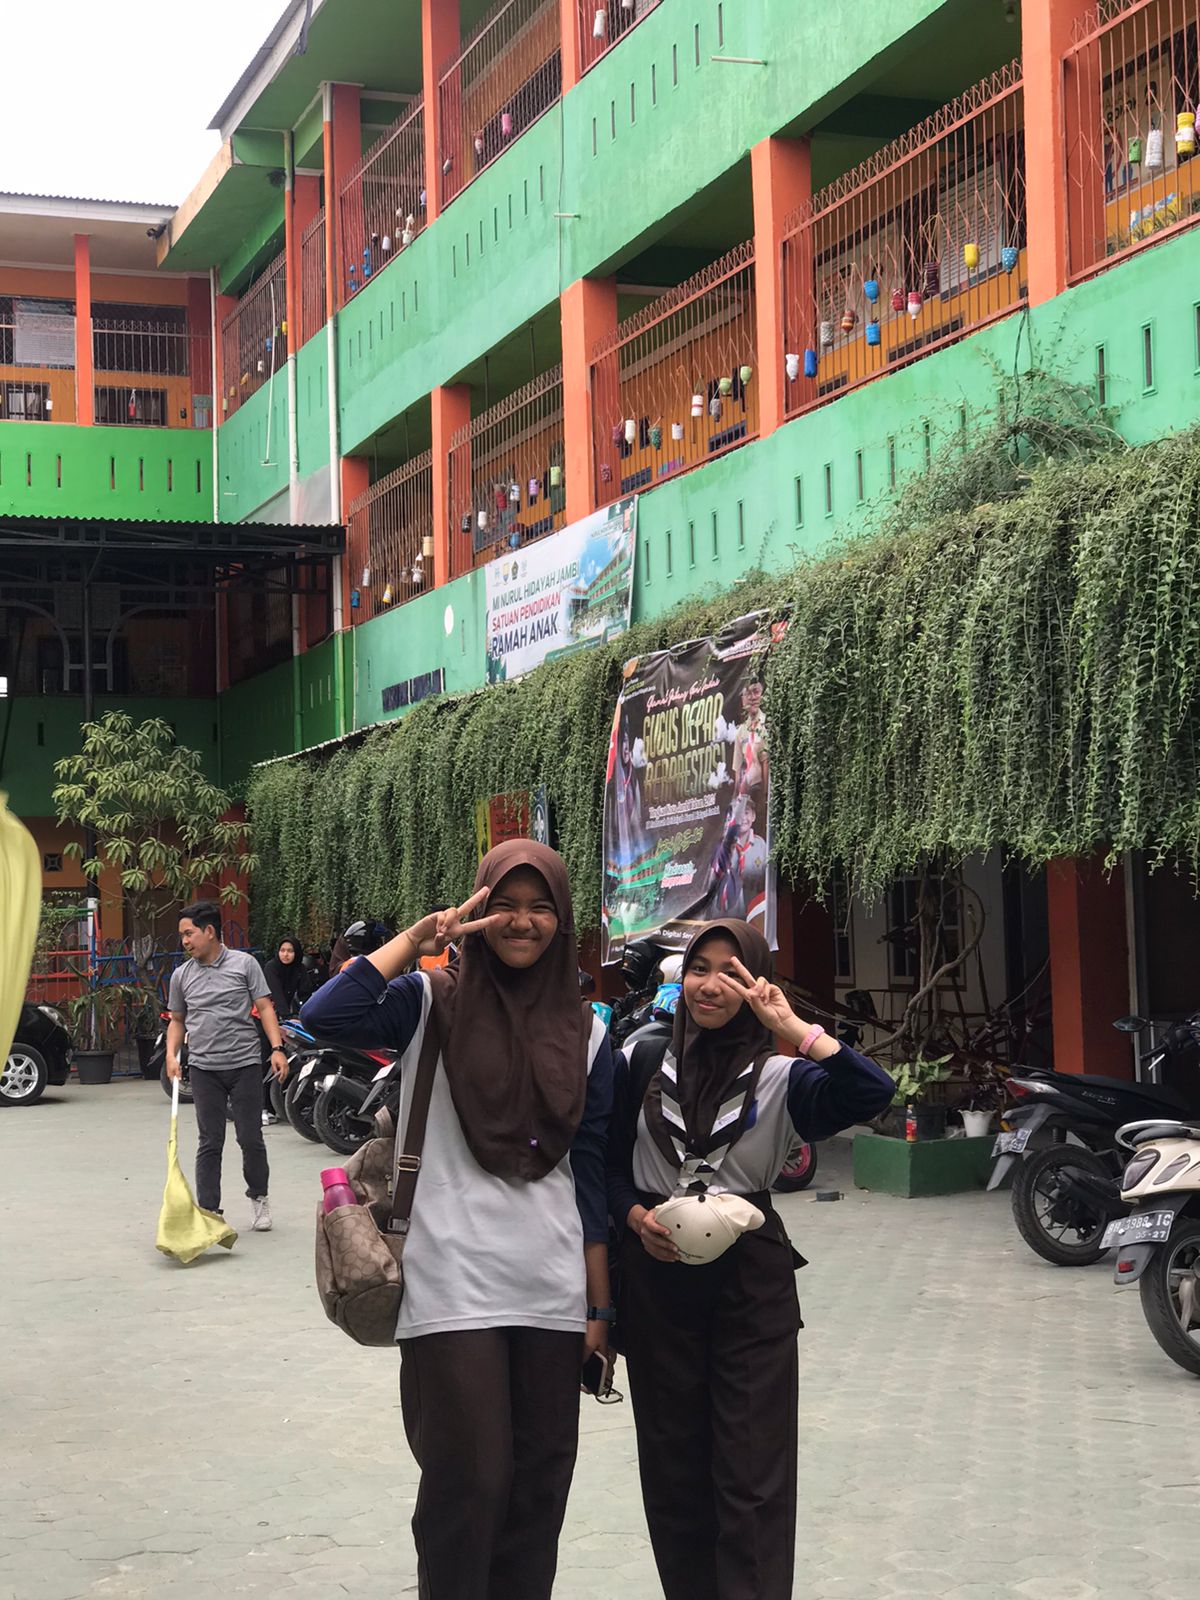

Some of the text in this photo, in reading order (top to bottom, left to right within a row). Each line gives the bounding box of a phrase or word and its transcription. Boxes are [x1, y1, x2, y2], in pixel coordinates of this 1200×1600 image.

[492, 596, 500, 610] MI
[501, 586, 522, 607] NURUL
[524, 575, 556, 598] HIDAYAH
[492, 592, 561, 633] SATUAN PENDIDIKAN
[492, 625, 528, 658] RAMAH
[529, 612, 559, 642] ANAK
